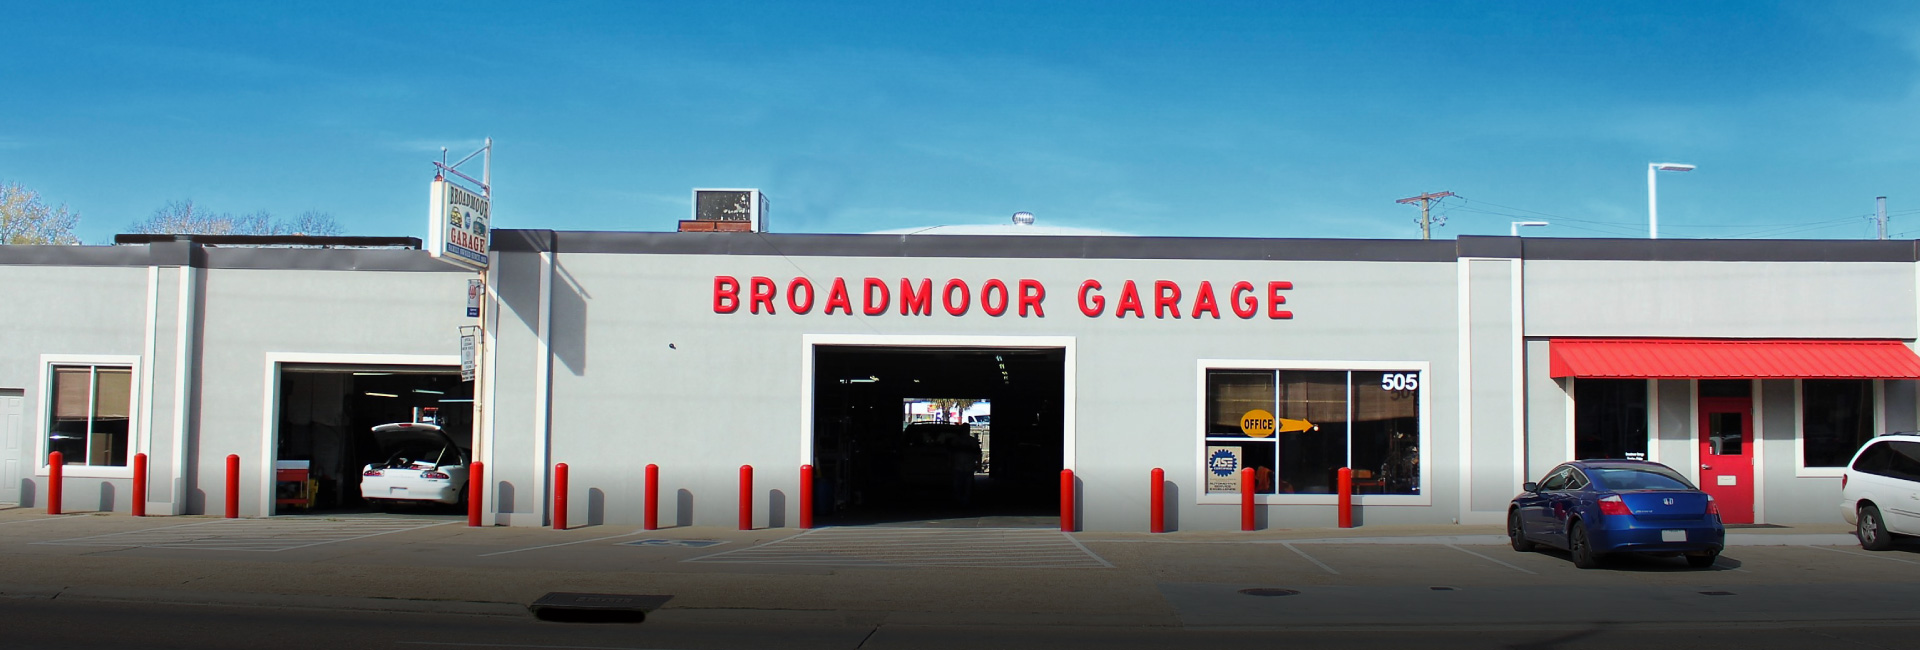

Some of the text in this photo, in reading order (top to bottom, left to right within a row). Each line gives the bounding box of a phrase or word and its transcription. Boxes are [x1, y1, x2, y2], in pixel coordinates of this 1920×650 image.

[450, 186, 489, 219] BROADMOOR
[450, 227, 485, 254] GARAGE
[713, 275, 1294, 319] BROADMOOR GARAGE
[1381, 373, 1418, 391] 505
[1244, 418, 1273, 430] OFFICE
[1212, 457, 1233, 467] ASE
